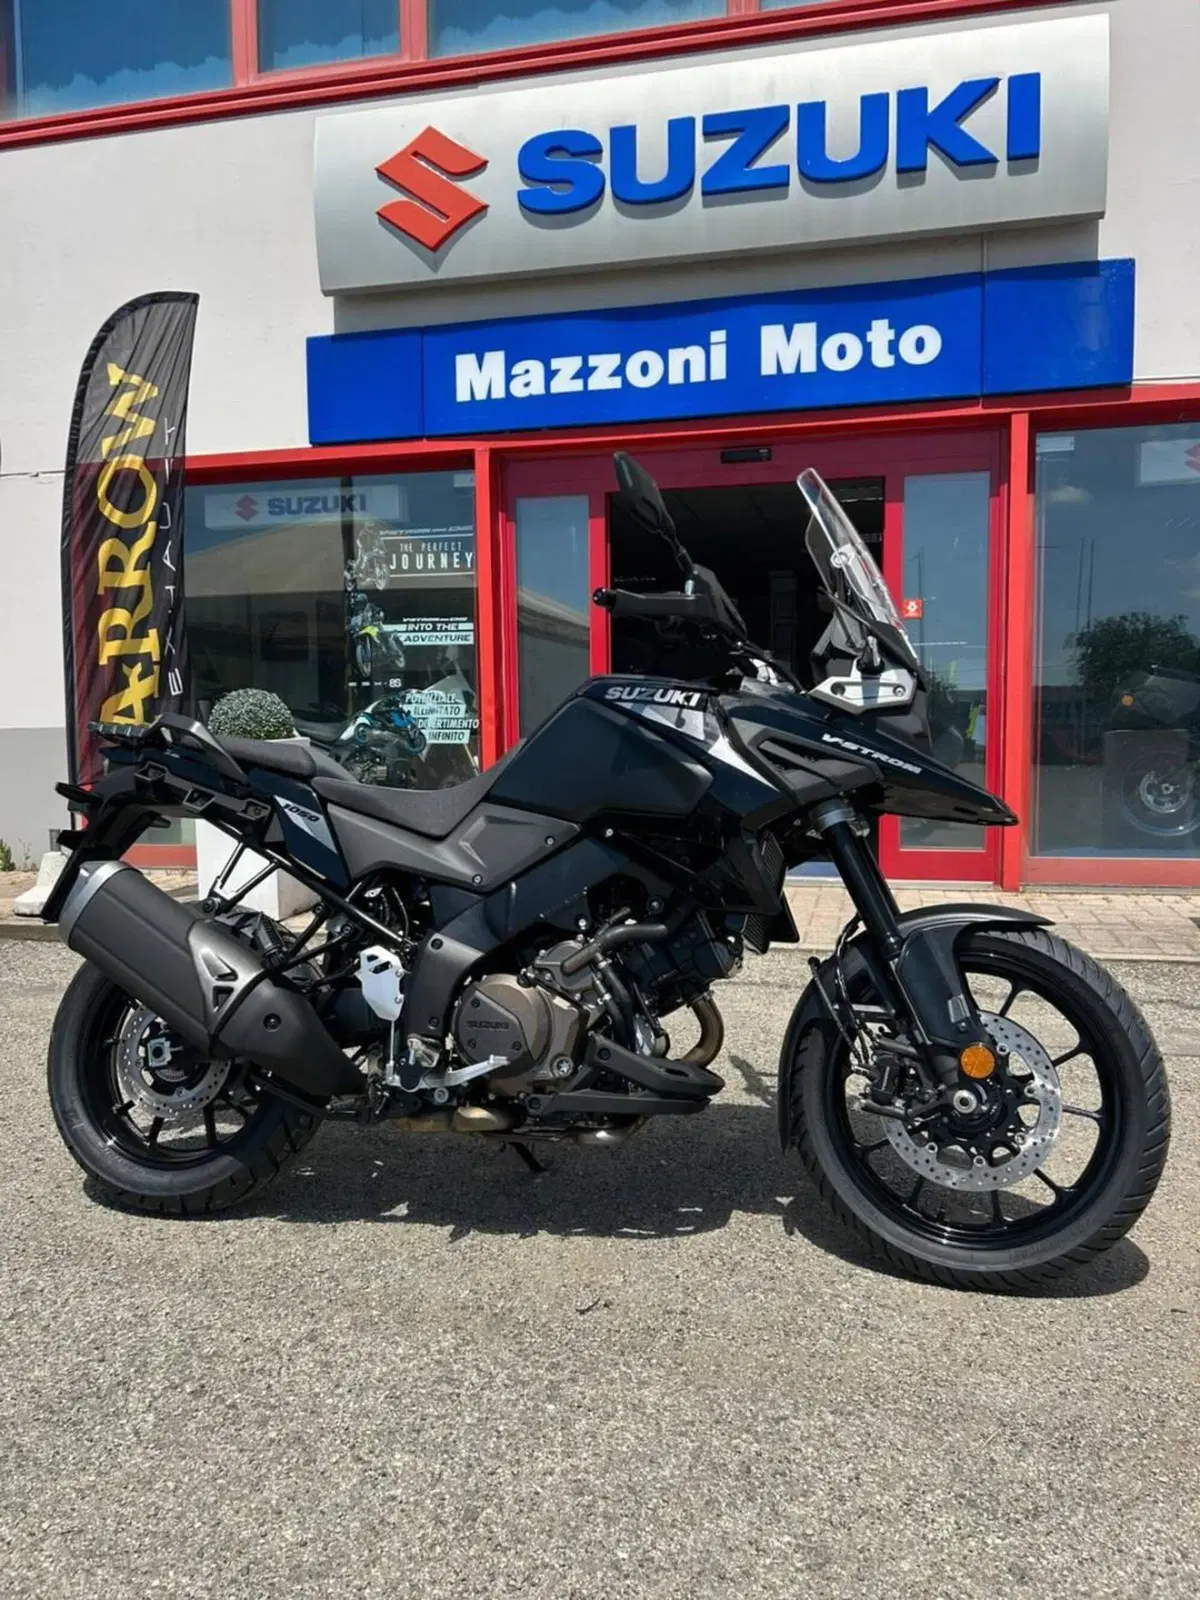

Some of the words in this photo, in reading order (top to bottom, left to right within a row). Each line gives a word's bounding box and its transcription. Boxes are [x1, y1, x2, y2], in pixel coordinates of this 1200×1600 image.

[517, 72, 1041, 215] SUZUKI
[455, 329, 727, 402] Mazzoni
[760, 318, 942, 376] Moto
[267, 494, 367, 517] SUZUKI
[97, 362, 159, 726] ARROW
[421, 541, 462, 552] PERFECT
[389, 551, 473, 570] JOURNEY
[407, 622, 433, 631] INTO
[436, 622, 459, 631] THE
[404, 633, 471, 643] ADVENTURE
[604, 685, 701, 707] SUZUKI
[428, 731, 465, 741] INFINITO
[820, 732, 923, 774] V-STROM
[282, 803, 320, 822] 1050
